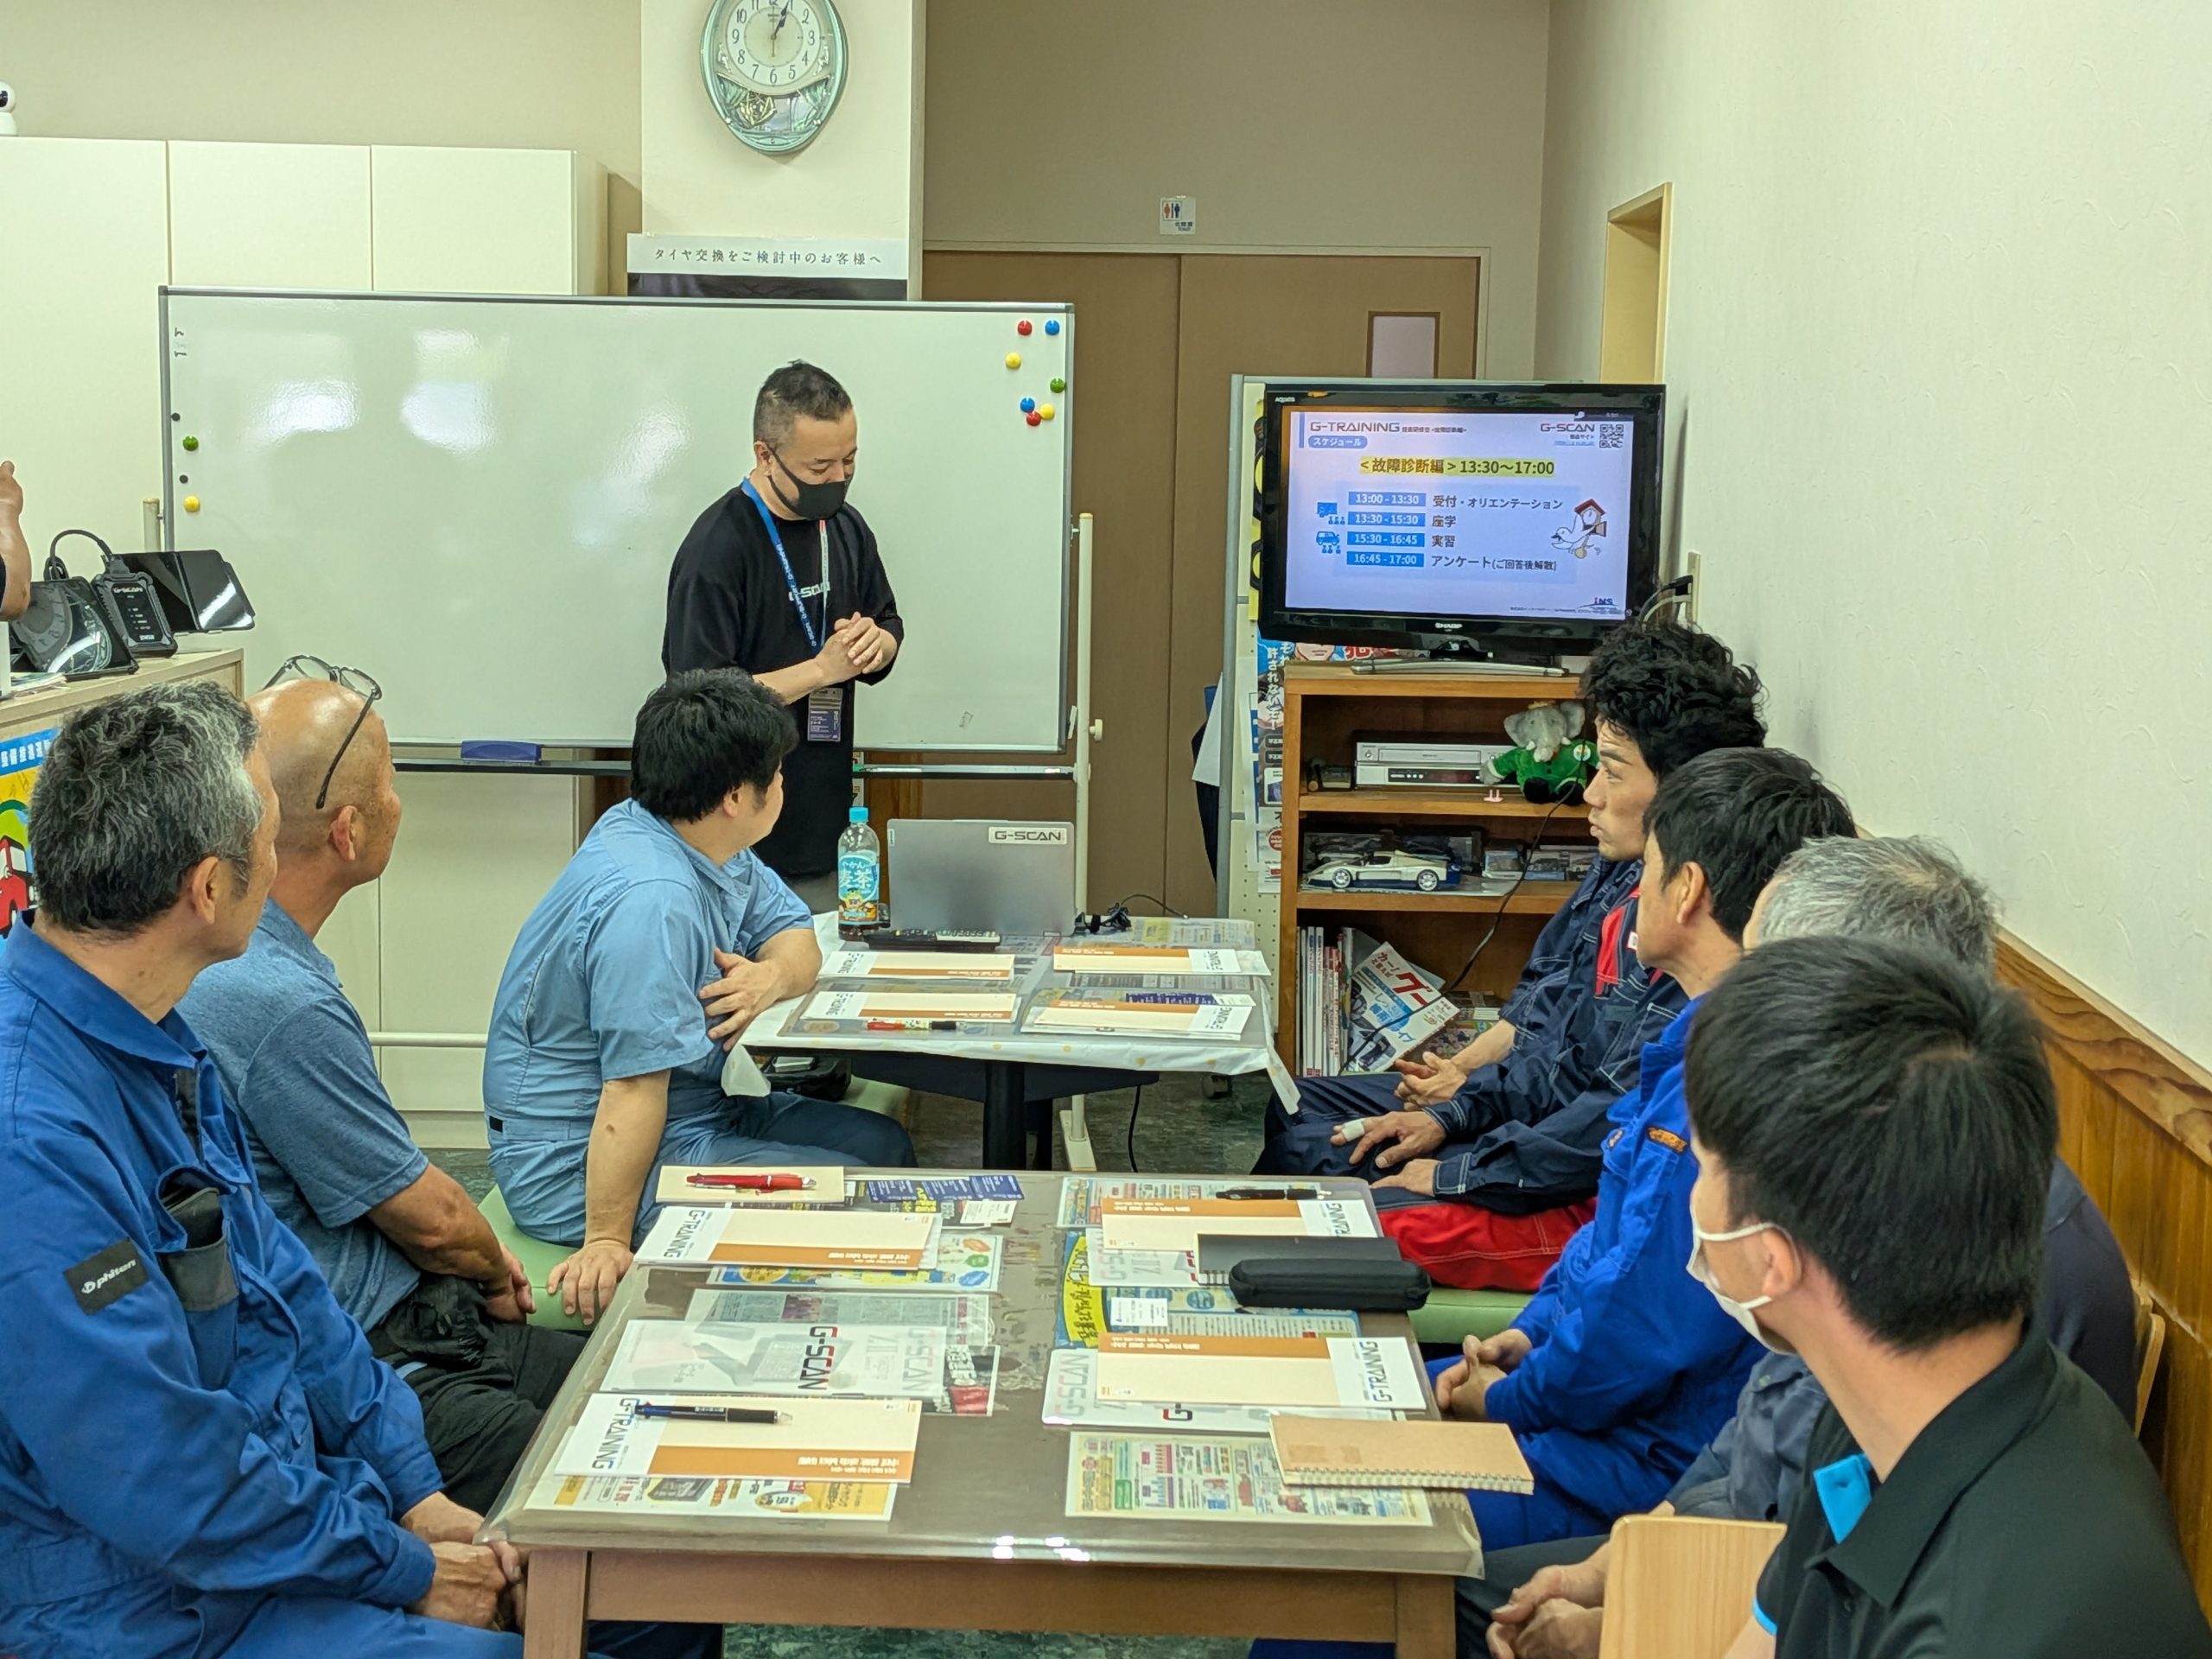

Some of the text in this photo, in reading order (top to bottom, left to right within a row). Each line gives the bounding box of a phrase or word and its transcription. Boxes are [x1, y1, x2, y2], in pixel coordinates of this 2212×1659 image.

[736, 9, 747, 23] 10
[802, 9, 810, 24] 2
[732, 29, 740, 44] 9
[808, 30, 815, 45] 3
[737, 49, 745, 65] 8
[802, 50, 809, 66] 4
[752, 64, 760, 79] 7
[769, 69, 778, 84] 6
[788, 65, 796, 79] 5
[654, 248, 882, 266] タイヤ交換をご検討中のお客様へ
[1310, 422, 1400, 432] G-TRAINING
[1540, 423, 1595, 432] G-SCAN
[1313, 437, 1362, 447] スケジュール
[1356, 493, 1382, 504] 13:00
[1392, 494, 1419, 505] 13:30
[1433, 495, 1563, 510] 受付・オリエンテーション
[1355, 513, 1382, 524] 13:30
[1390, 515, 1418, 524] 15:30
[1354, 533, 1382, 544] 15:30
[1390, 534, 1417, 544] 16:45
[1432, 536, 1455, 548] 実習
[1354, 554, 1381, 564] 16:45
[1389, 555, 1417, 565] 17:00
[995, 830, 1061, 841] G-SCAN
[1392, 971, 1433, 1007] グー
[664, 1210, 706, 1258] G-TRAINING
[97, 1259, 136, 1289] phiten
[798, 1325, 838, 1390] G-SCAN
[1359, 1341, 1393, 1402] G-TRAINING
[591, 1398, 640, 1470] G-TRAINING
